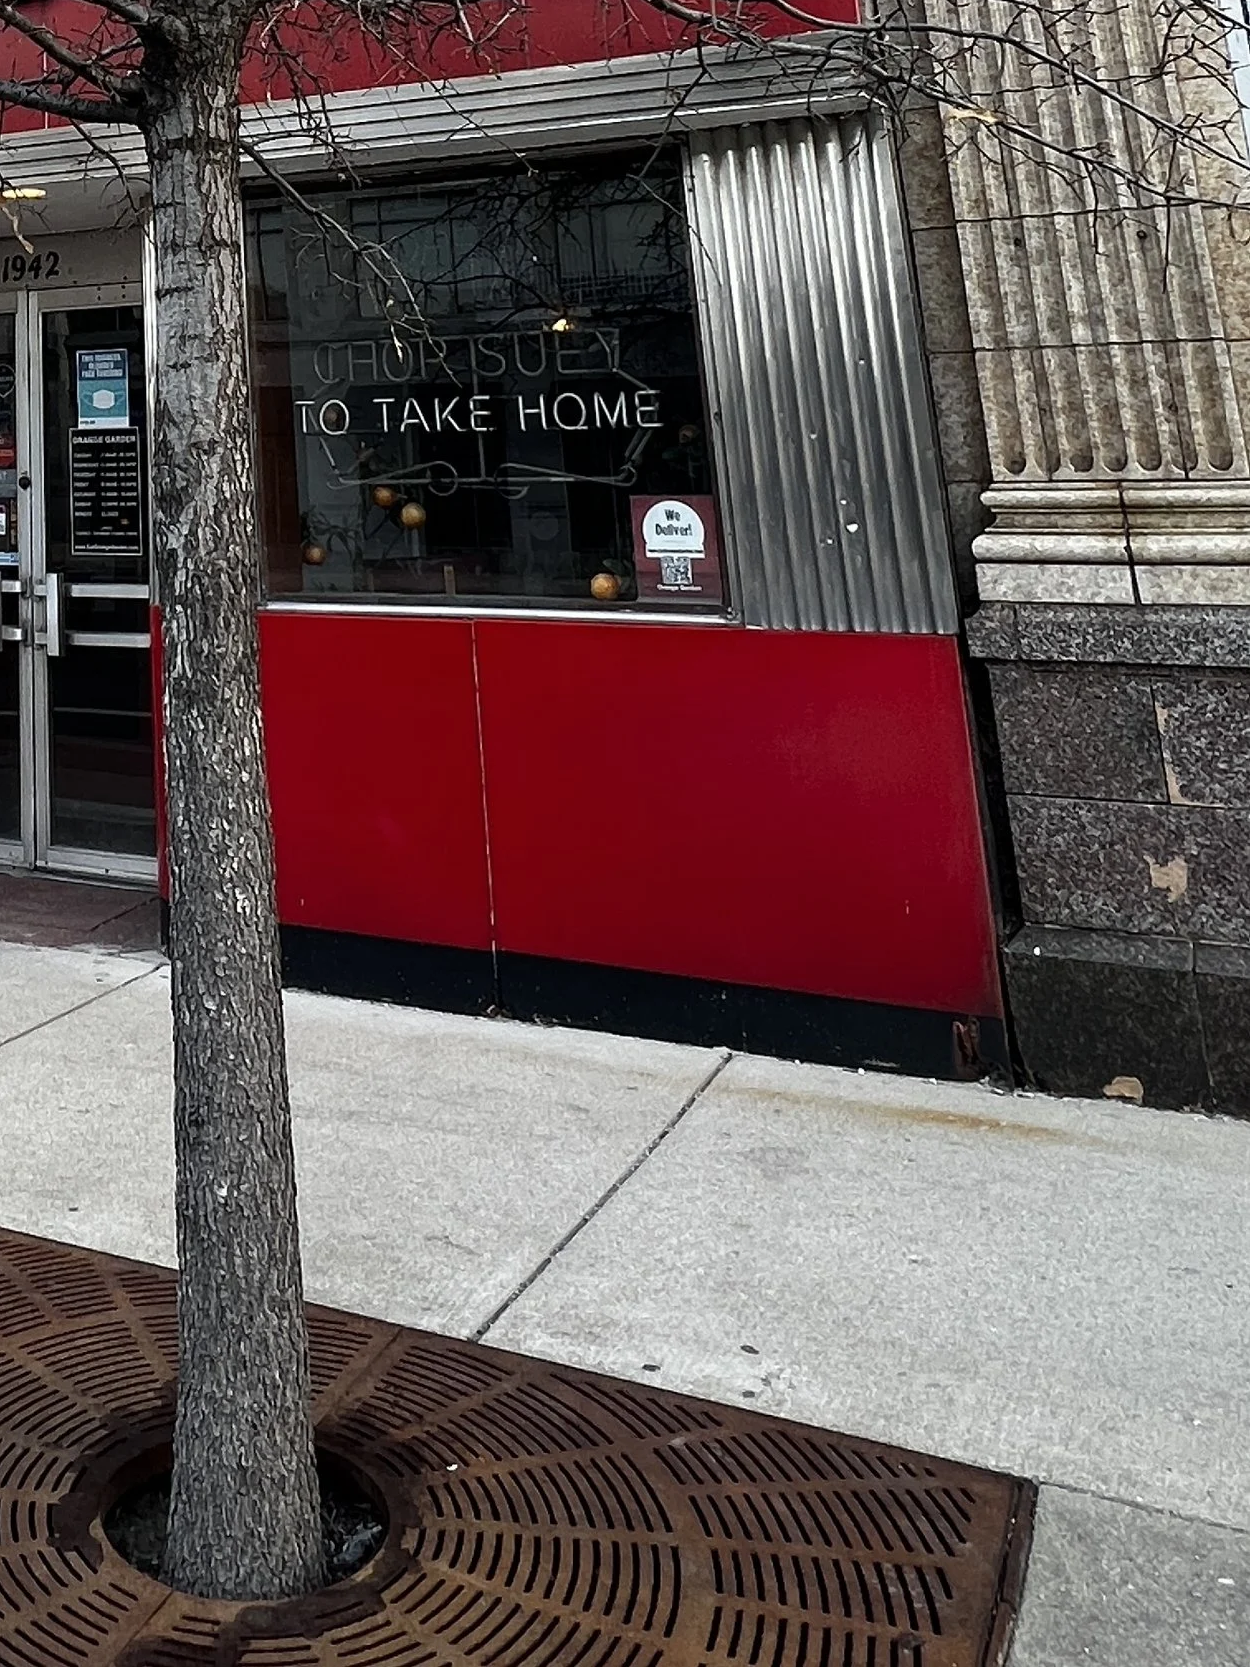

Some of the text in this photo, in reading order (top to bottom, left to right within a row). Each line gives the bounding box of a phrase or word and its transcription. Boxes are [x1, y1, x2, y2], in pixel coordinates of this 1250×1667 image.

[2, 251, 61, 284] 1942
[314, 328, 620, 384] CHOP SUEY
[294, 389, 664, 435] TO TAKE HOME
[655, 523, 693, 537] Deliver!
[663, 508, 681, 522] We
